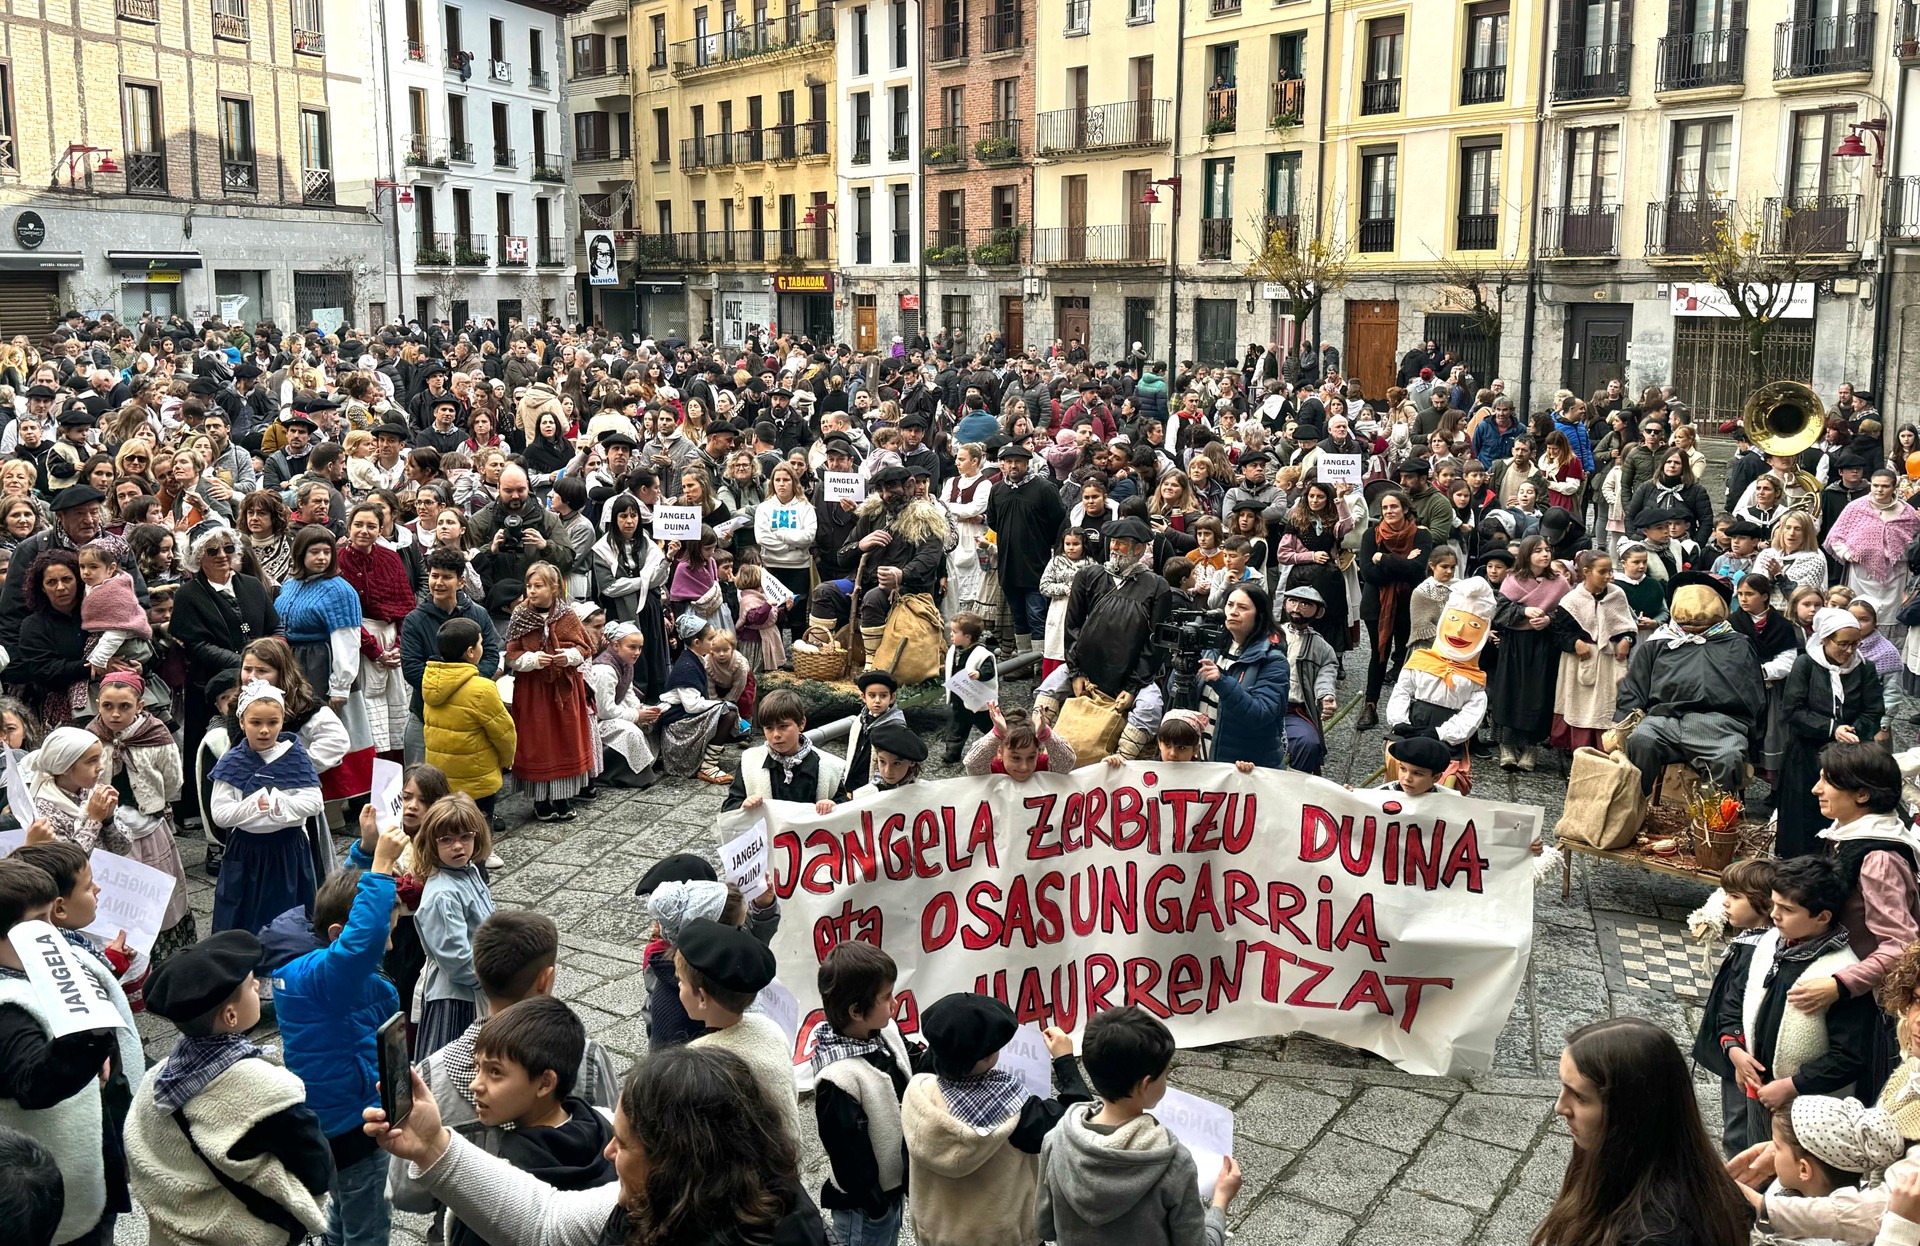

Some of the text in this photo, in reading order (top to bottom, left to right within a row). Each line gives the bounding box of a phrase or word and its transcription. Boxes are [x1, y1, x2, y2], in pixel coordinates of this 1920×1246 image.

[787, 276, 825, 287] TABAKOAK
[725, 301, 742, 320] GAZTE
[829, 477, 859, 485] JANGELA
[659, 511, 696, 520] JANGELA
[664, 523, 690, 531] DUINA
[765, 575, 787, 598] JANGELA
[766, 585, 781, 603] DUINA
[731, 836, 764, 871] JANGELA
[738, 862, 761, 887] DUINA
[813, 899, 883, 966] eta
[35, 934, 90, 1014] JANGELA
